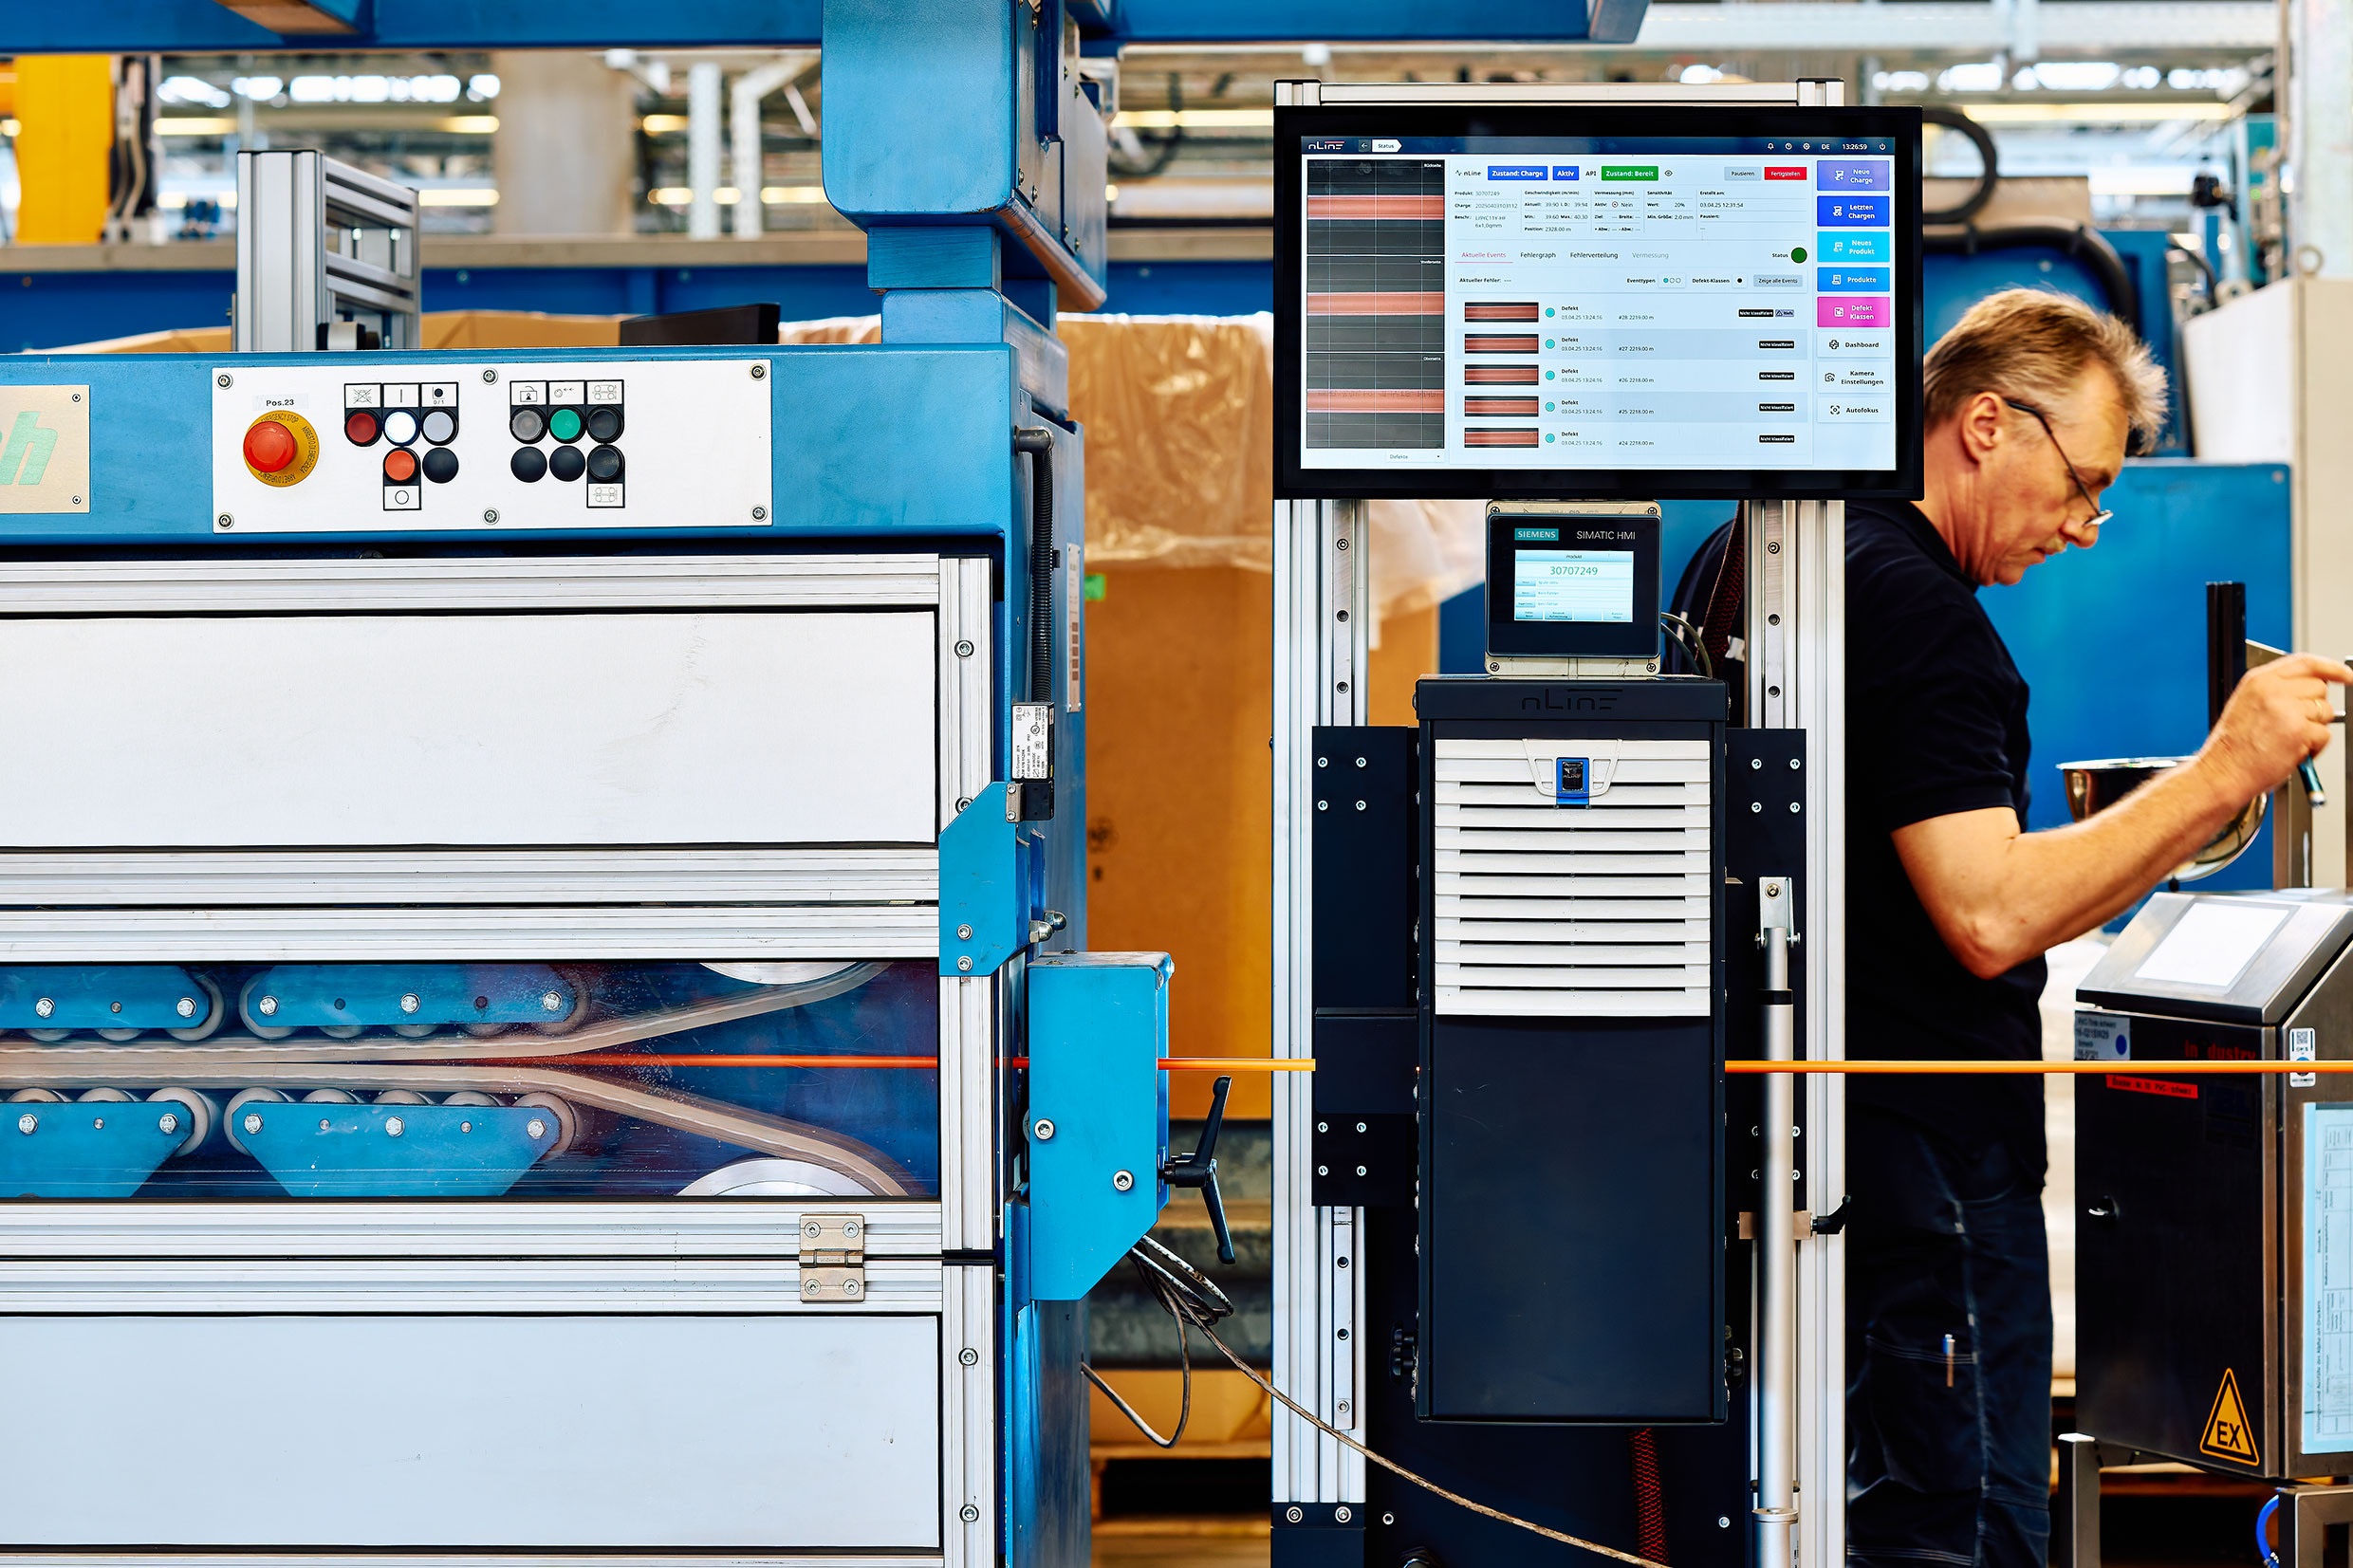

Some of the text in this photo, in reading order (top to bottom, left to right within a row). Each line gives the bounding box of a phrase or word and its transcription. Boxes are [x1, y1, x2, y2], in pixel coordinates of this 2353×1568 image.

[266, 398, 295, 407] Pos.23
[1576, 530, 1636, 540] SIMATIC HMI
[1549, 566, 1598, 576] 30707249
[2216, 1419, 2242, 1450] EX
